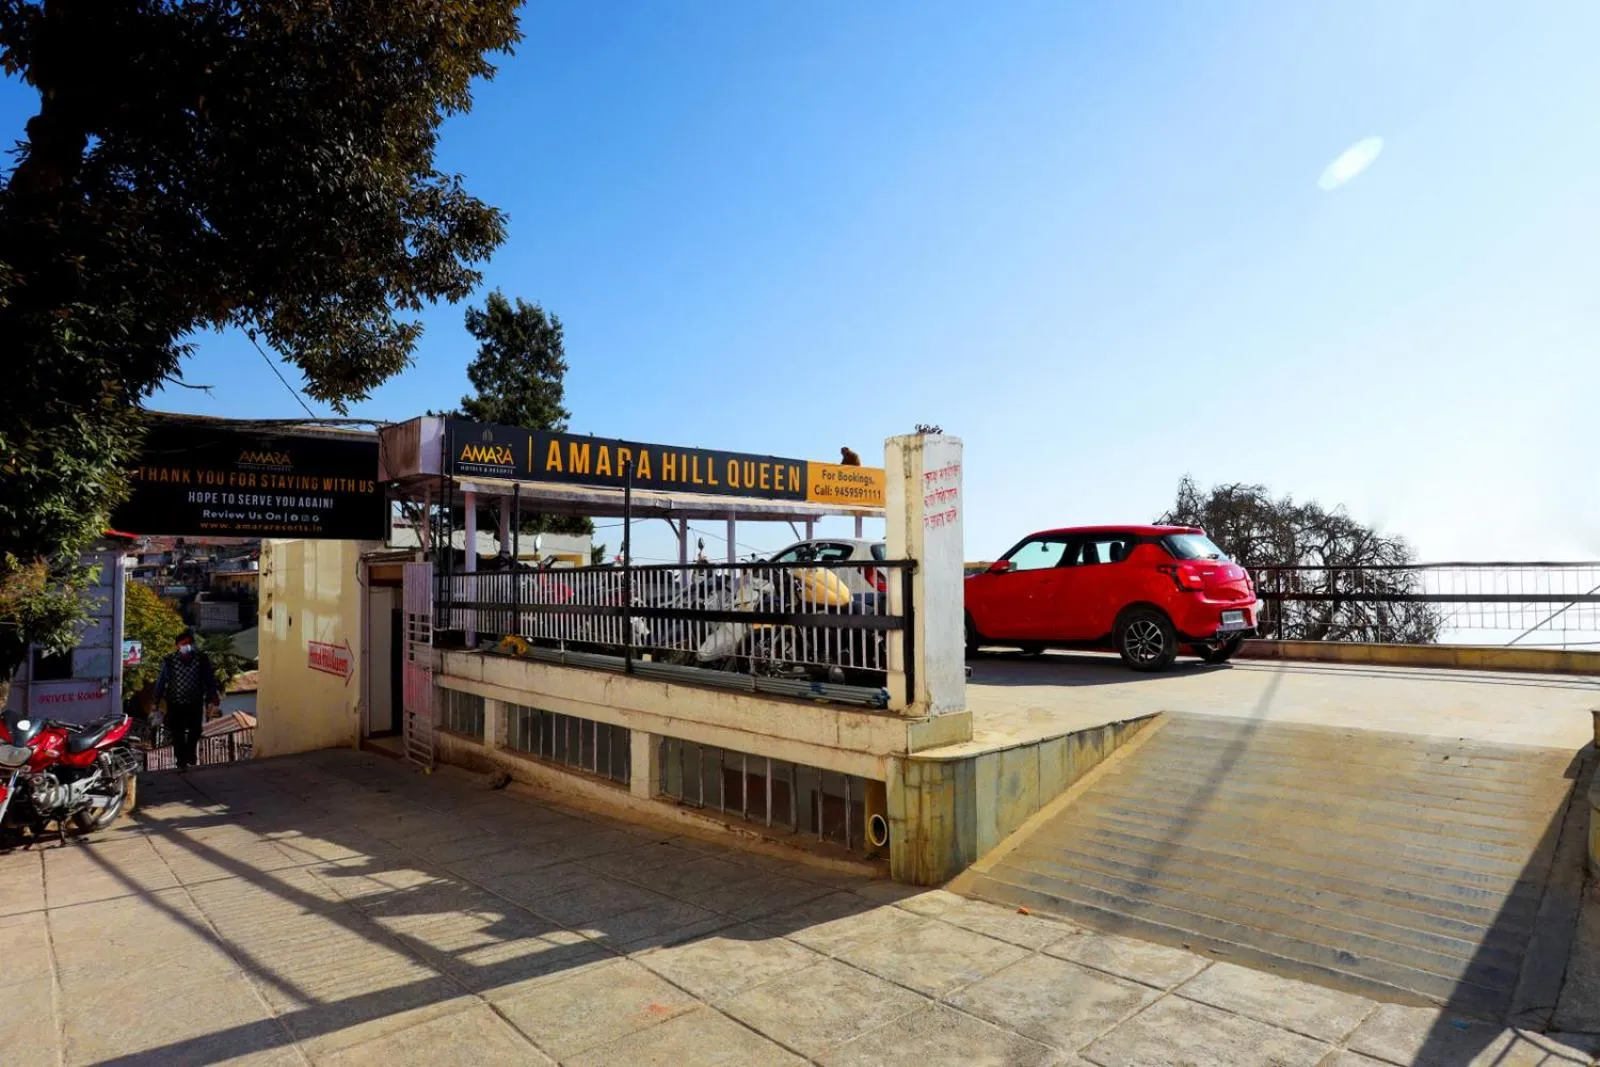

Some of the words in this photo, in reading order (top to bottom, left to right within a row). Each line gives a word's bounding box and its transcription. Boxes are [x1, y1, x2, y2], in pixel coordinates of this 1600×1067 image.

[239, 450, 293, 466] AMARA
[460, 444, 514, 465] AMARA
[138, 466, 191, 484] THANK
[196, 471, 224, 486] YOU
[229, 472, 256, 487] FOR
[260, 474, 319, 491] STAYING
[322, 478, 356, 493] WITH
[358, 480, 375, 494] US
[661, 452, 719, 486] HILL
[727, 459, 801, 493] QUEEN
[821, 469, 836, 481] For
[814, 484, 833, 496] Call:
[188, 491, 218, 504] HOPE
[222, 493, 235, 505] TO
[238, 494, 273, 507] SERVE
[275, 495, 296, 508] YOU
[298, 497, 334, 509] AGAIN!
[203, 509, 245, 520] Review
[248, 510, 263, 521] Us
[265, 512, 282, 522] On
